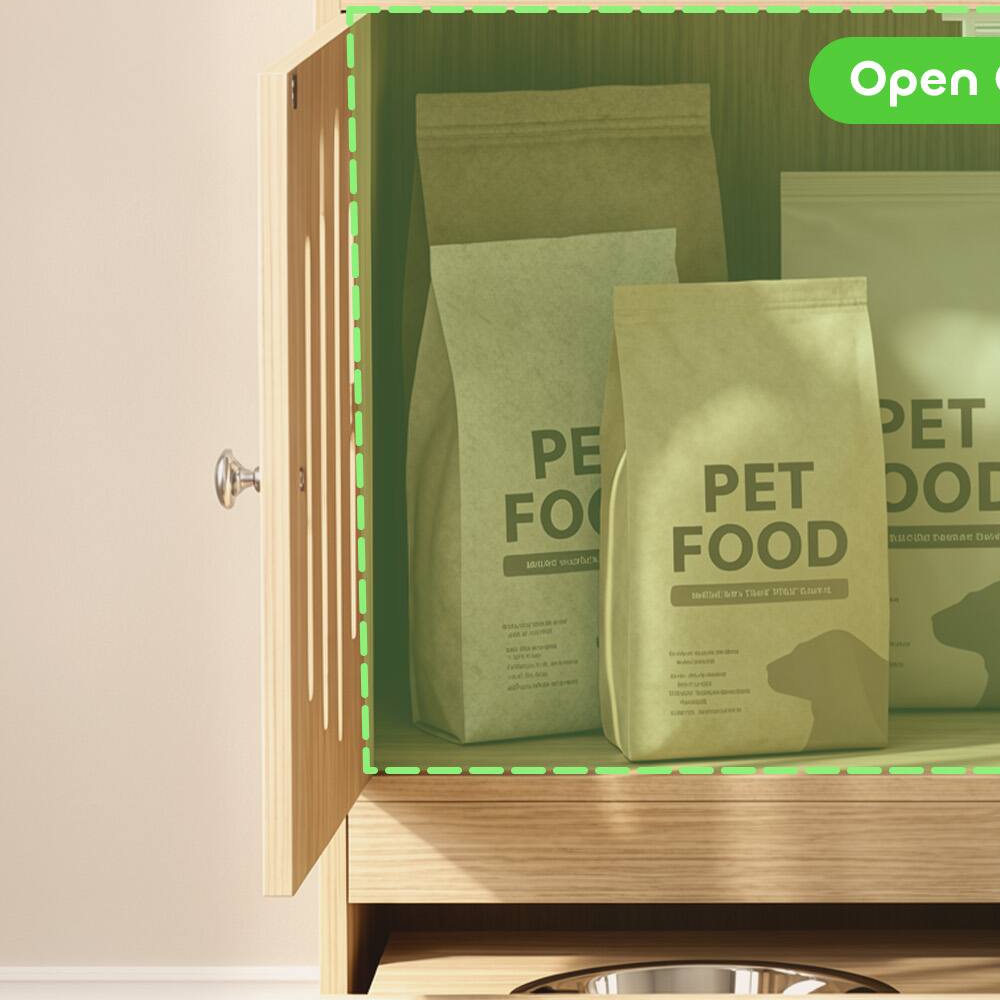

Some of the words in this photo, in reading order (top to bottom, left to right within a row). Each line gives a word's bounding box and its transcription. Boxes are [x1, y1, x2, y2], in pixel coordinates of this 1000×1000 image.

[531, 426, 602, 480] PE
[704, 461, 814, 513] PET
[505, 488, 602, 543] FO
[673, 520, 848, 573] FOOD
